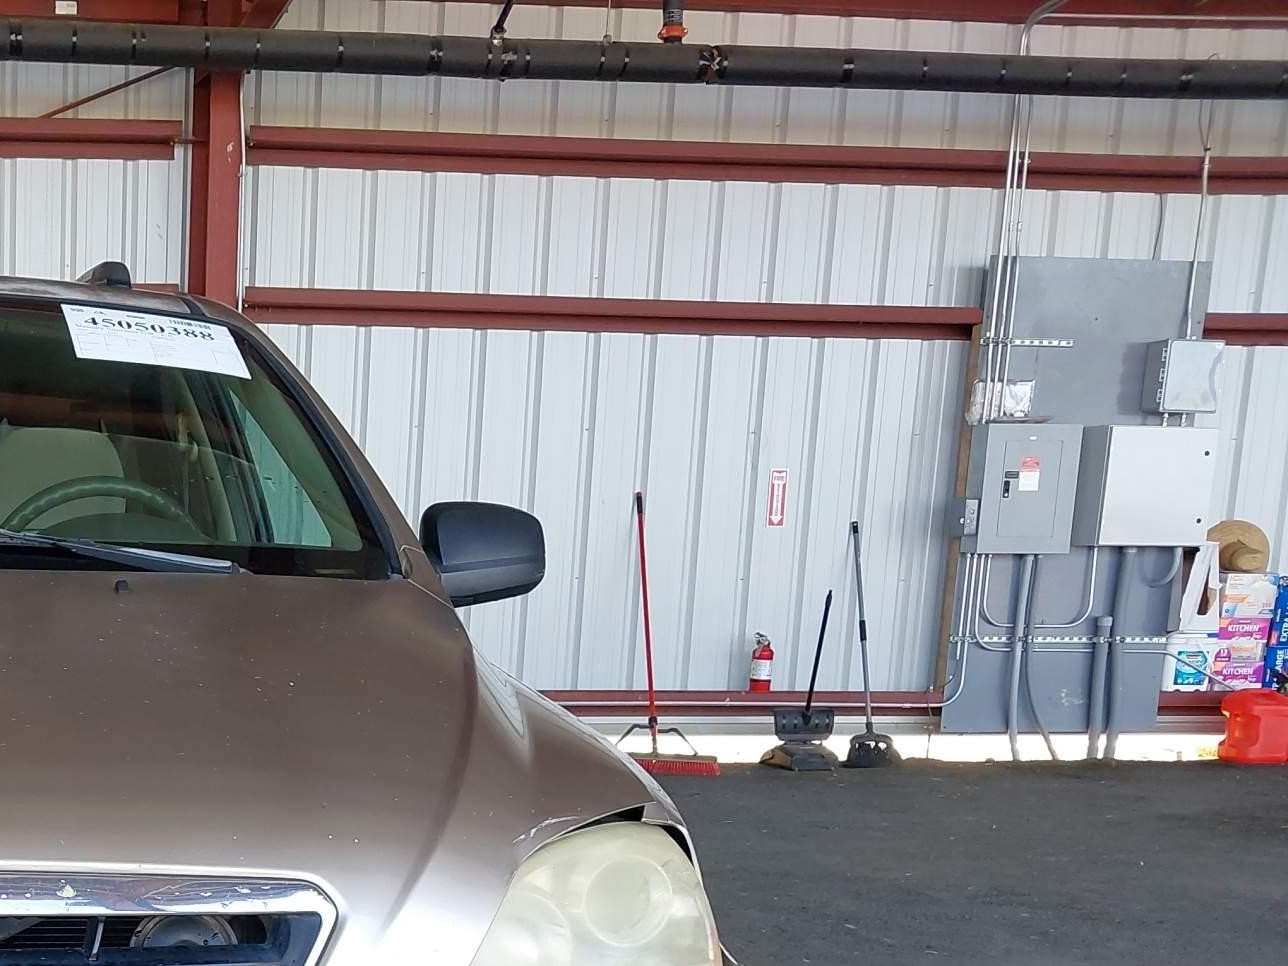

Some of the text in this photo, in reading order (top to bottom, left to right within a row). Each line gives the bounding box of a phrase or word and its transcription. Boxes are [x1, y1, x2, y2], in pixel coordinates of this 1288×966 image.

[83, 316, 216, 342] 45050388
[1228, 624, 1259, 632] KITCHEN
[1222, 667, 1254, 675] KITCHEN
